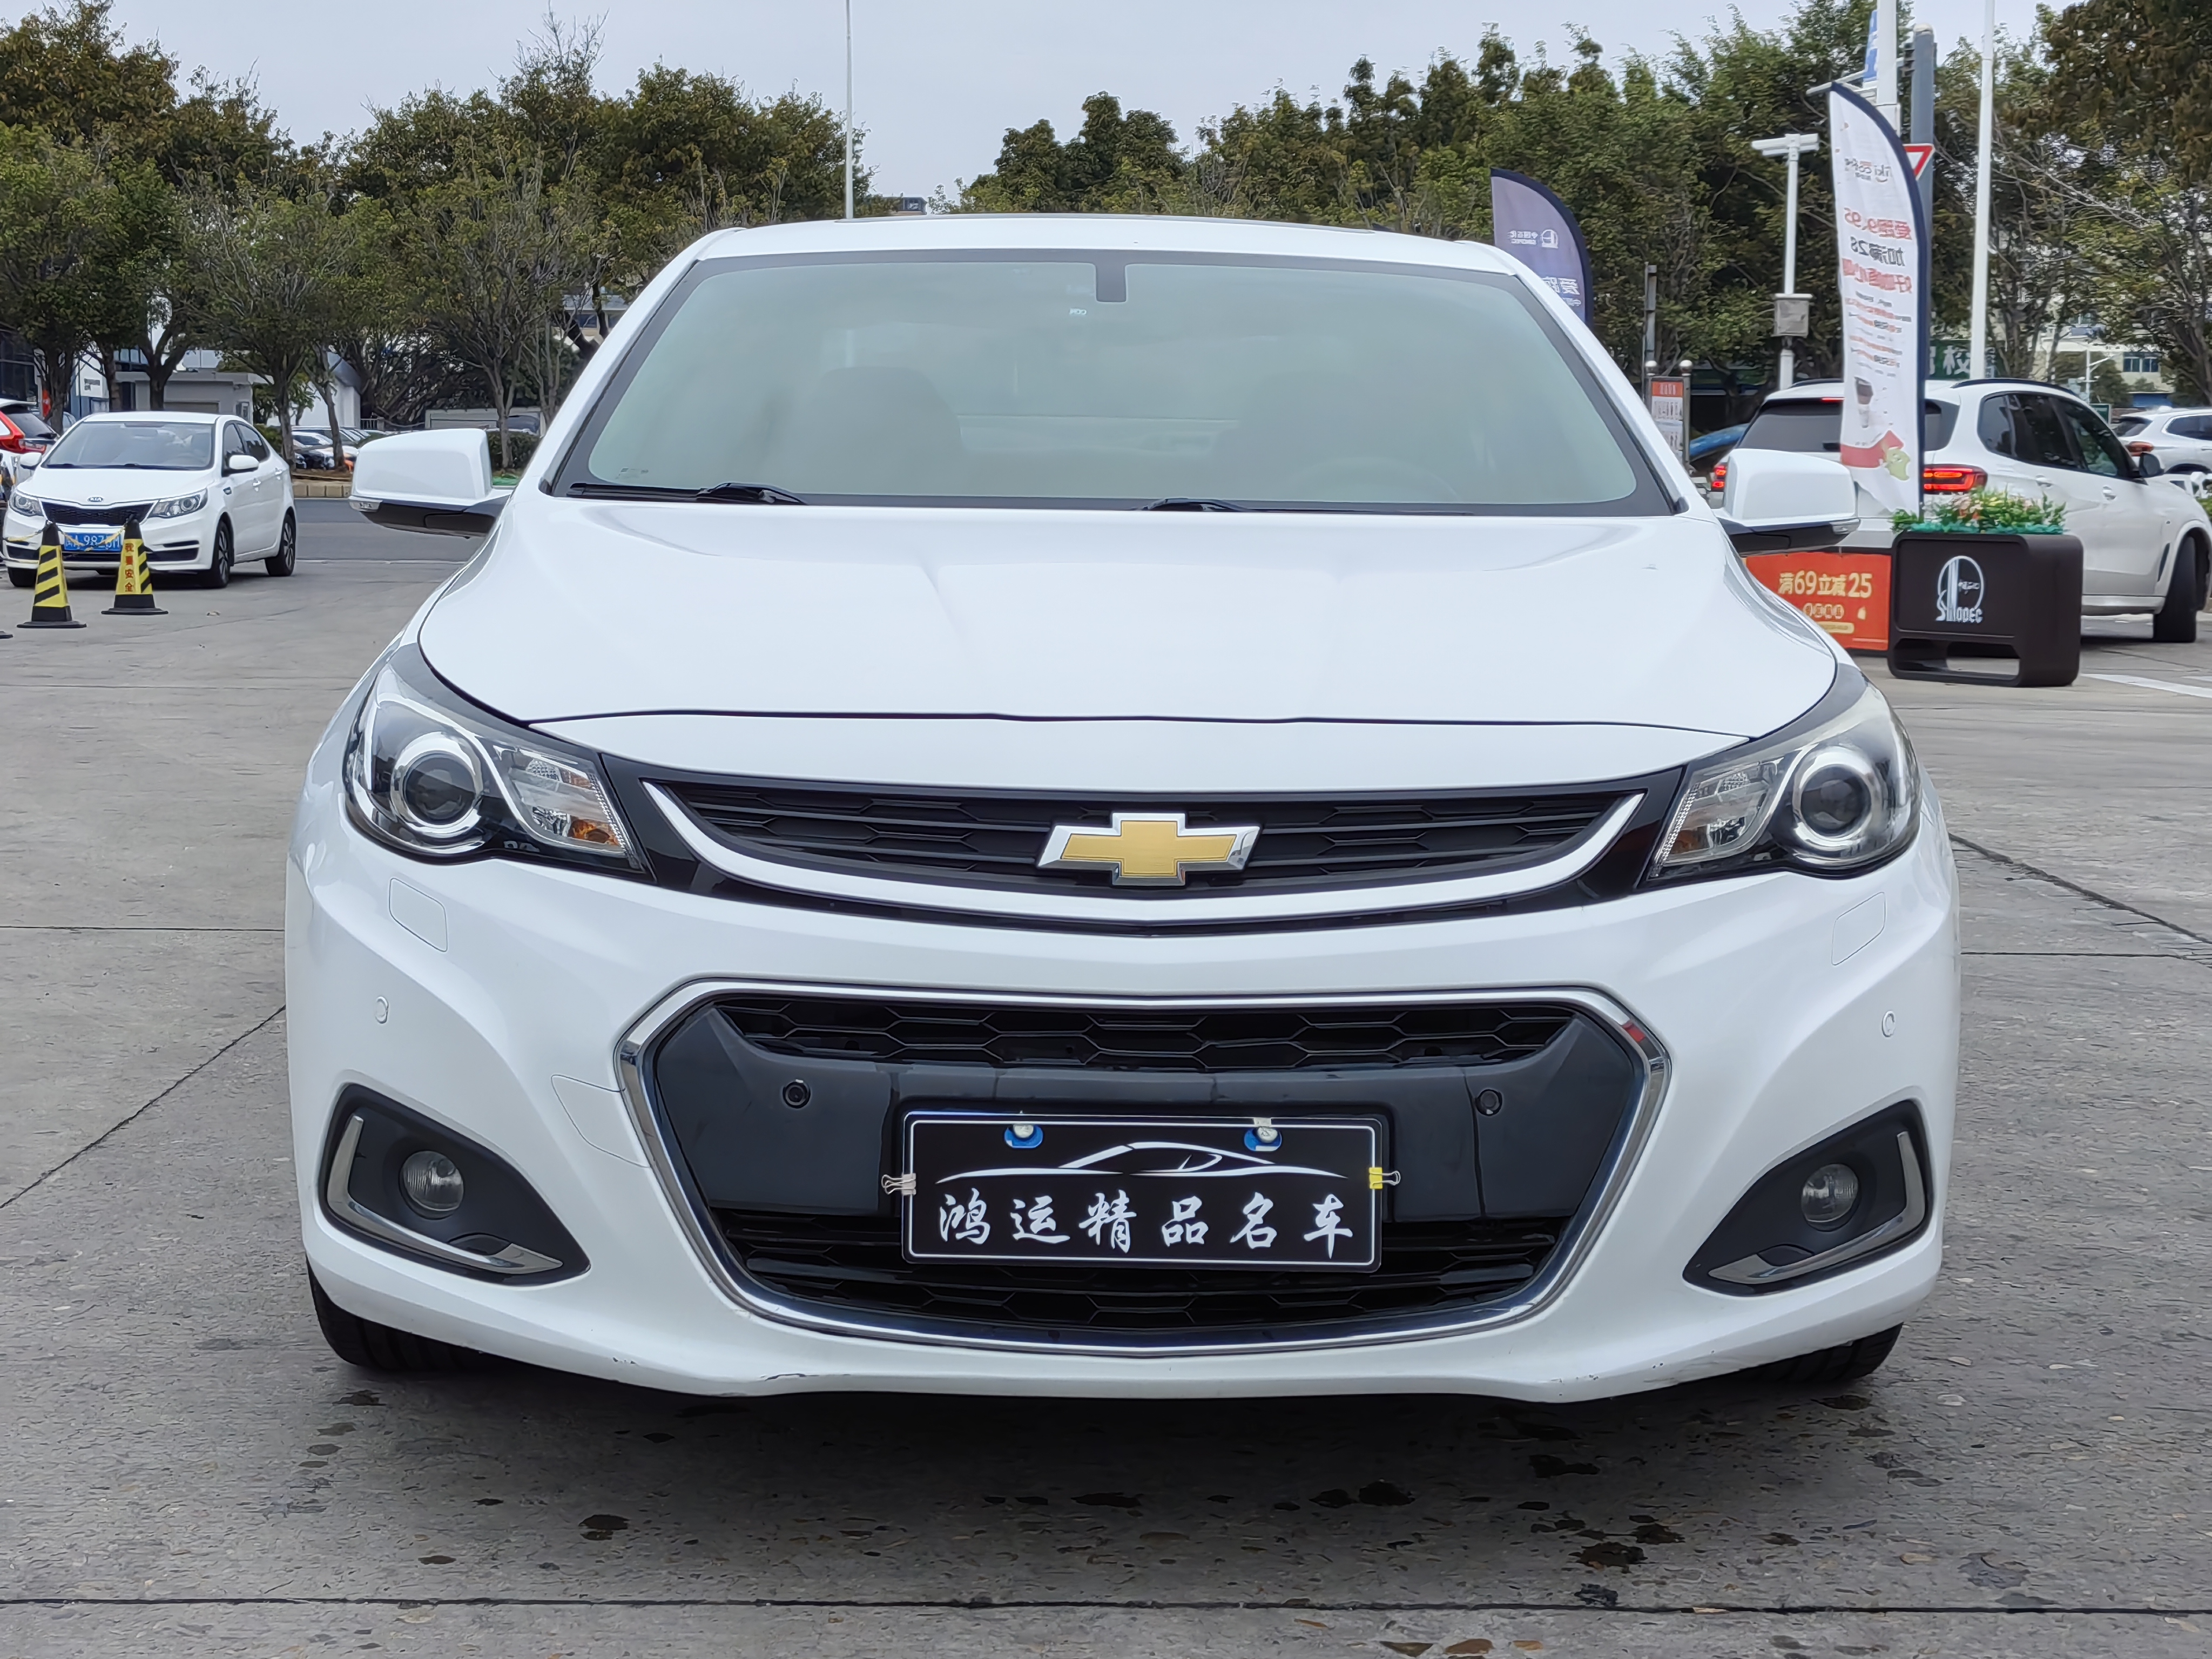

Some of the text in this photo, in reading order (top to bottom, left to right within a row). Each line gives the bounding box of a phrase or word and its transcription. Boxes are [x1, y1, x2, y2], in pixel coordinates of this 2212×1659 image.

[1778, 570, 1872, 598] 满69立减25
[939, 1188, 1353, 1259] 鸿运精品名车
